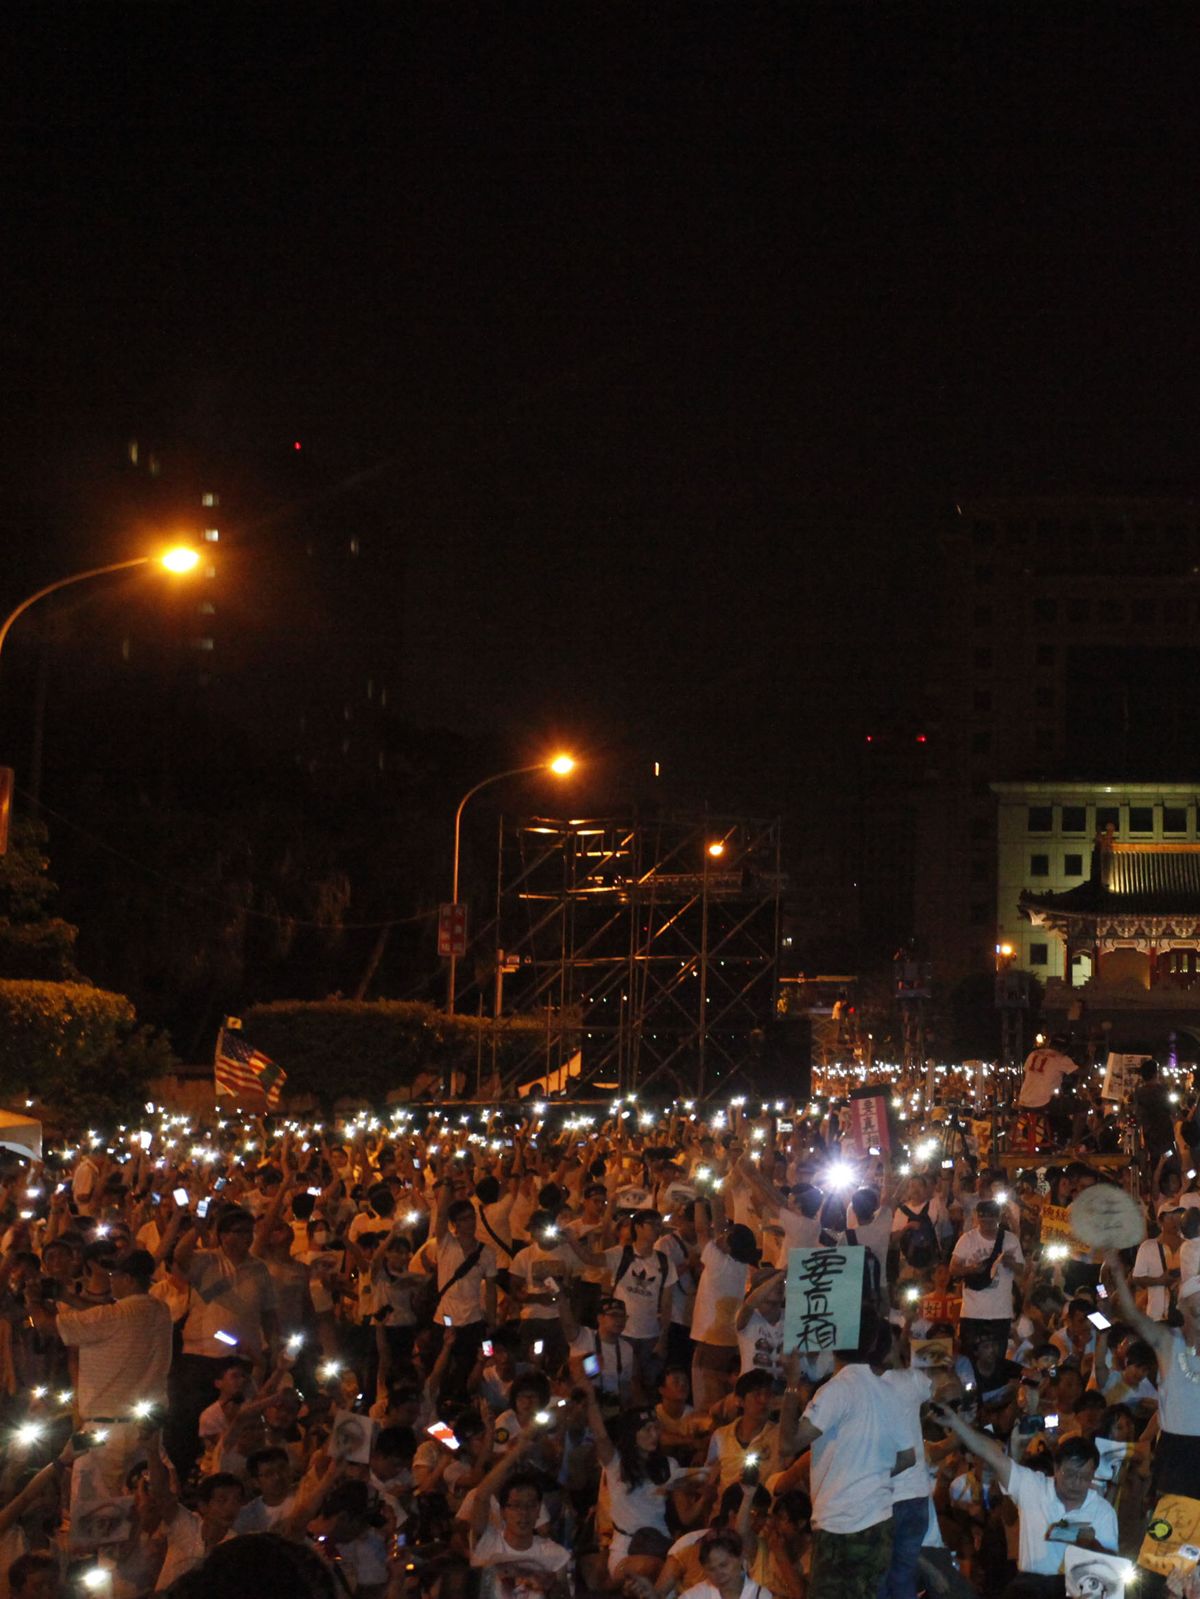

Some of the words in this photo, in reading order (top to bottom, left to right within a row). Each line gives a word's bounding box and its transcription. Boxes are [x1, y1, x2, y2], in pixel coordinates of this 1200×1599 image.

[1029, 1055, 1048, 1073] 11
[796, 1248, 847, 1350] 要真相
